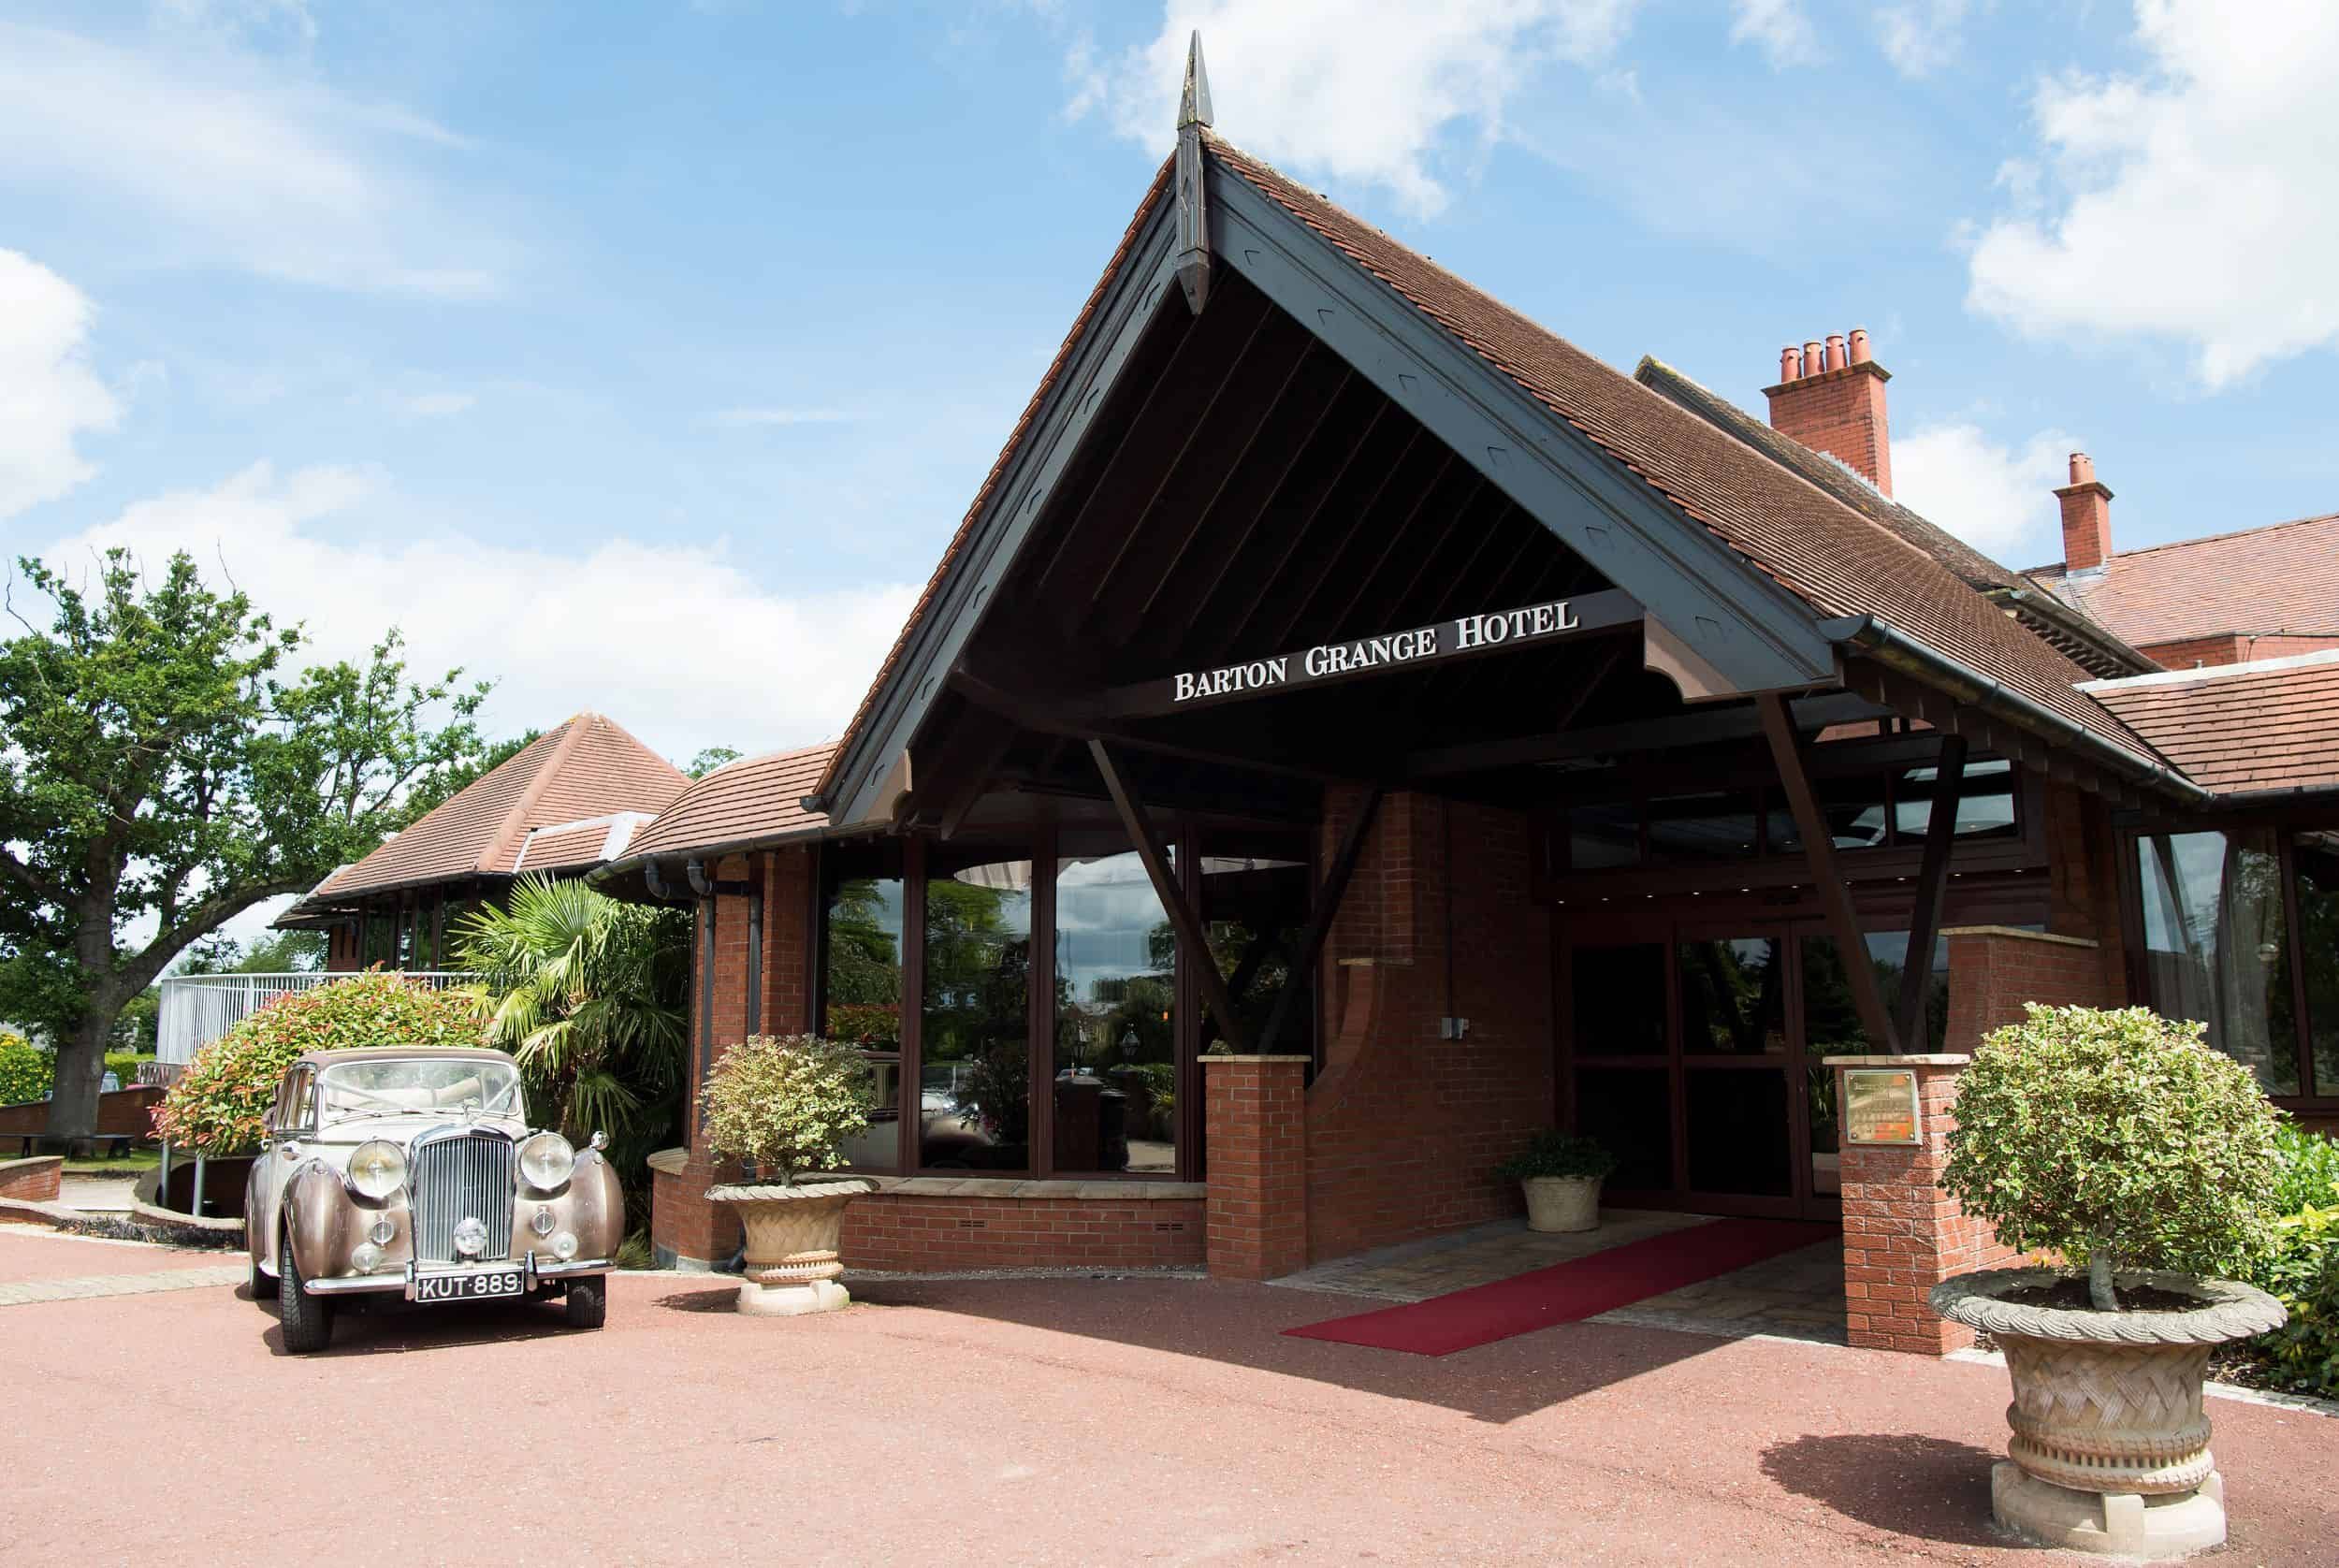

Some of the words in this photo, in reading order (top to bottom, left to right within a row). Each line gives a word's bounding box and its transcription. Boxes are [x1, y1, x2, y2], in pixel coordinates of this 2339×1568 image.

[1174, 659, 1287, 702] BARTON
[1305, 629, 1437, 677] GRANGE
[1456, 603, 1578, 649] HOTEL
